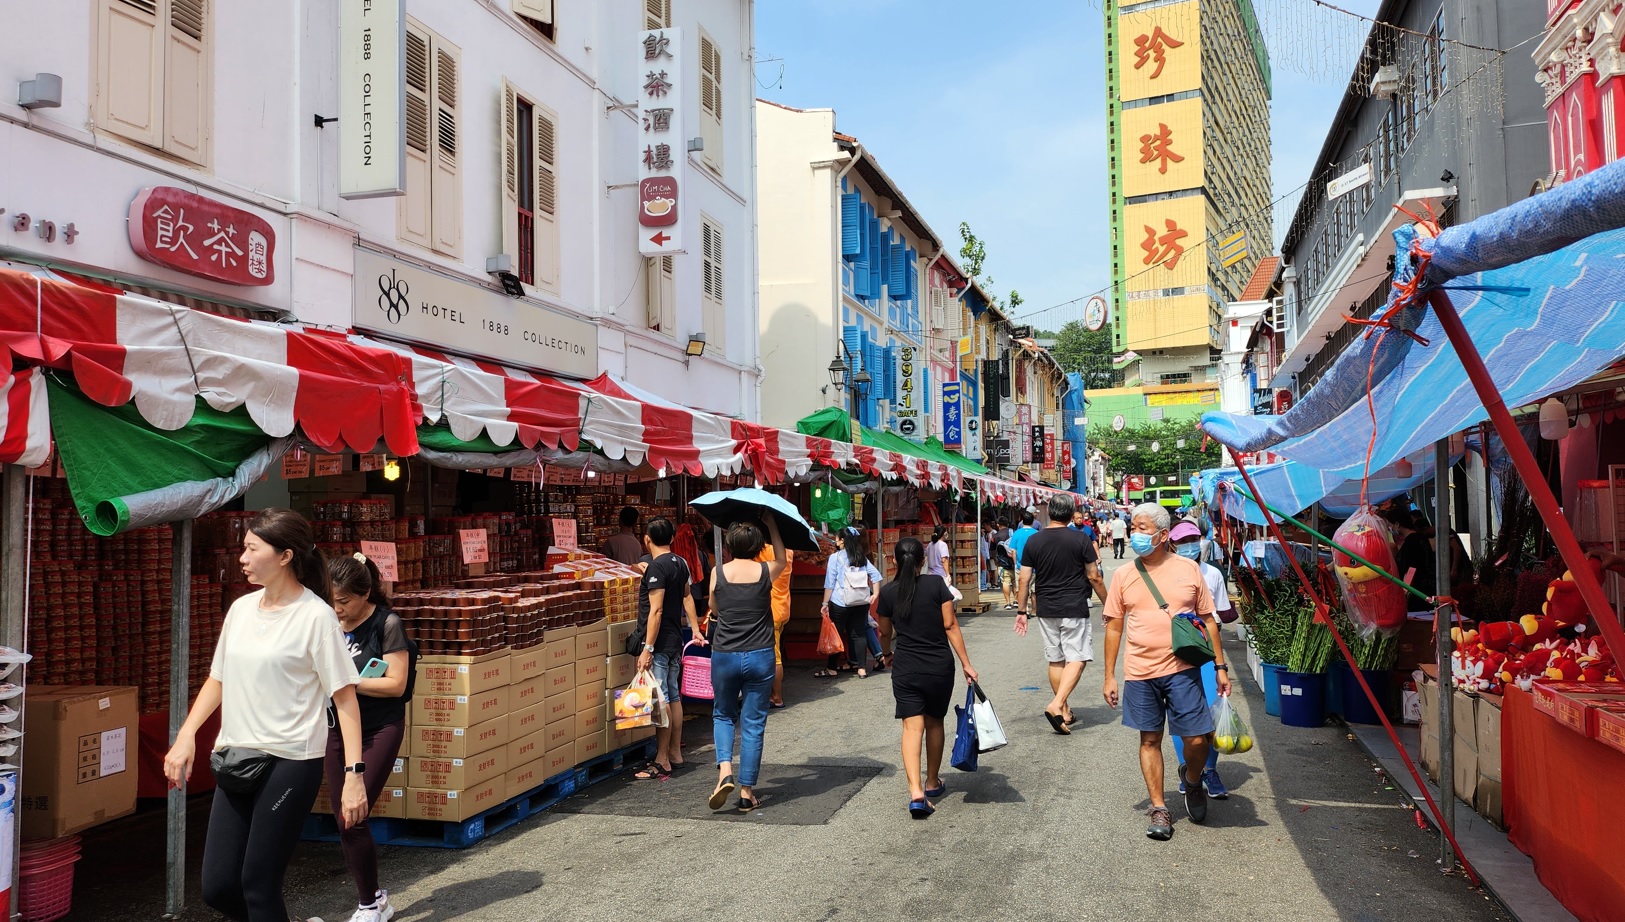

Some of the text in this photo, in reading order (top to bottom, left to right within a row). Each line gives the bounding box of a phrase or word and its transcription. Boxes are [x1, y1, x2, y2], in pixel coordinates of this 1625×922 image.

[363, 28, 371, 60] 1888
[363, 73, 372, 166] COLLECTION
[642, 31, 674, 170] 飲茶酒樓
[1134, 26, 1188, 270] 珍珠坊
[152, 204, 244, 269] 飲茶
[249, 237, 266, 279] 酒楼
[421, 301, 586, 356] HOTEL 1888 COLLECTION
[901, 346, 914, 409] 3941
[897, 410, 918, 418] CAFE
